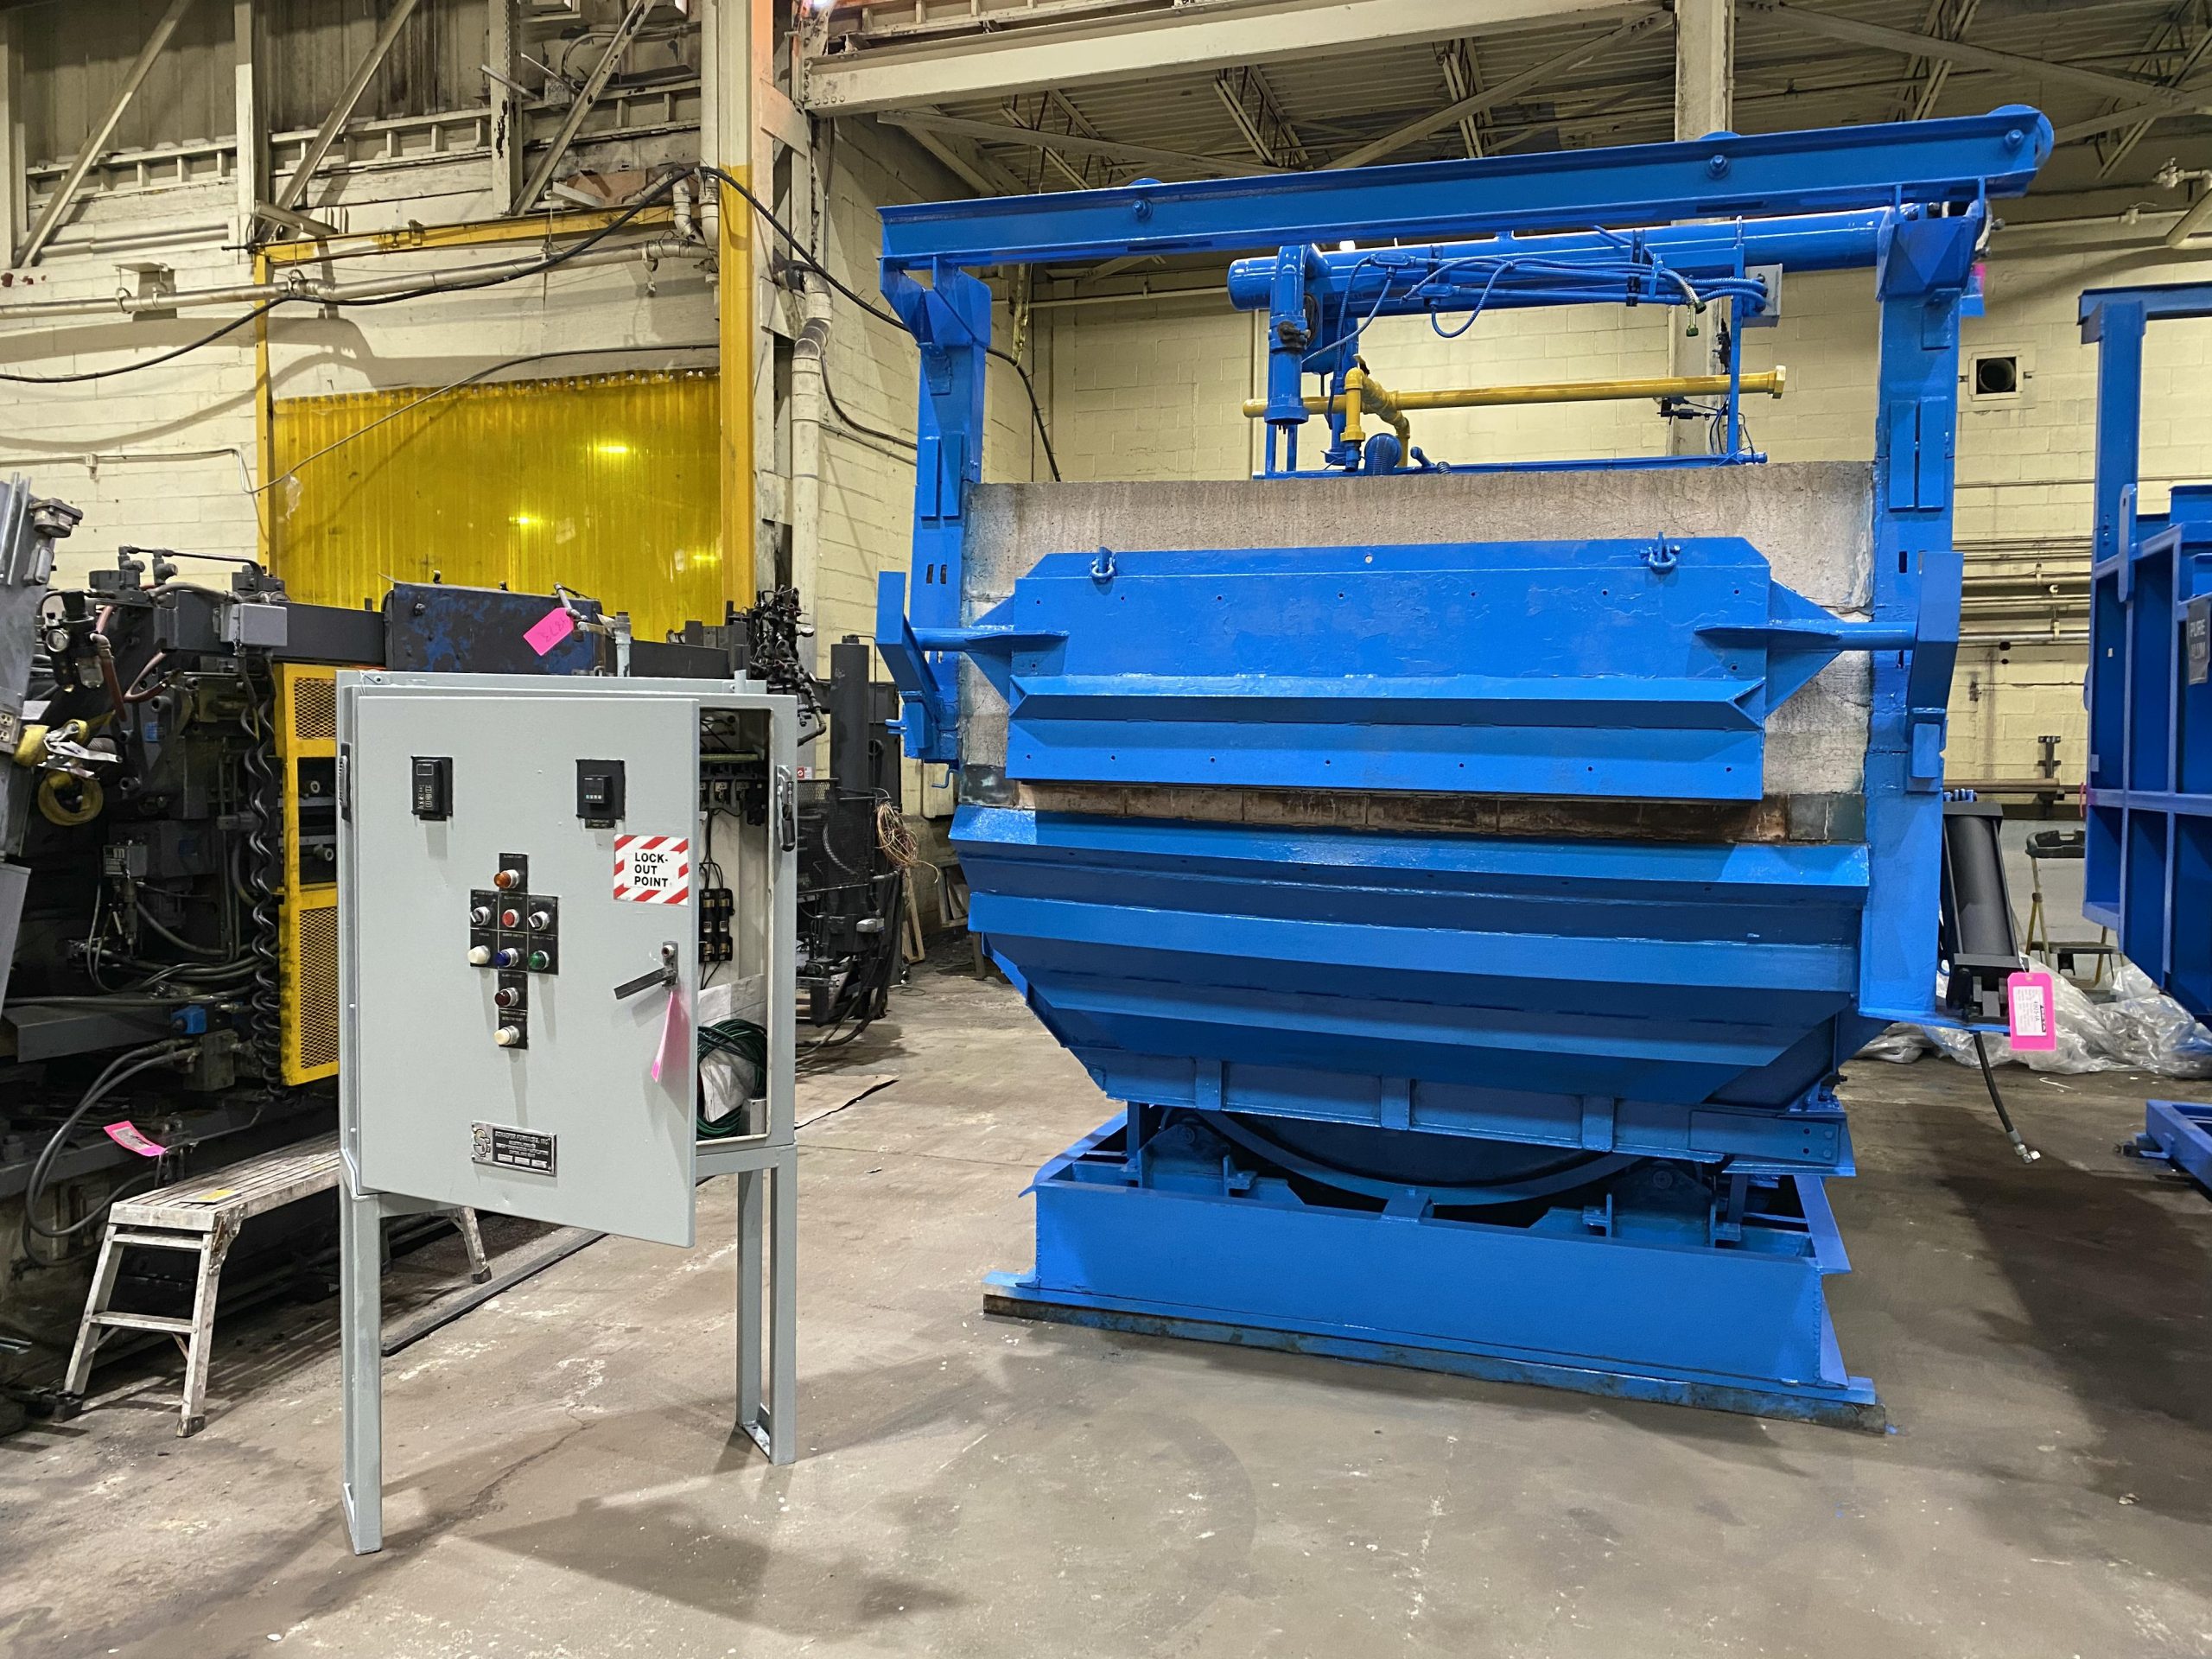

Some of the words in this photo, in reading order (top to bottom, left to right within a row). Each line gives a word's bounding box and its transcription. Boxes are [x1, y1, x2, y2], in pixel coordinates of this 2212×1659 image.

[634, 852, 668, 863] LOCK-
[634, 864, 658, 874] OUT
[634, 875, 668, 887] POINT
